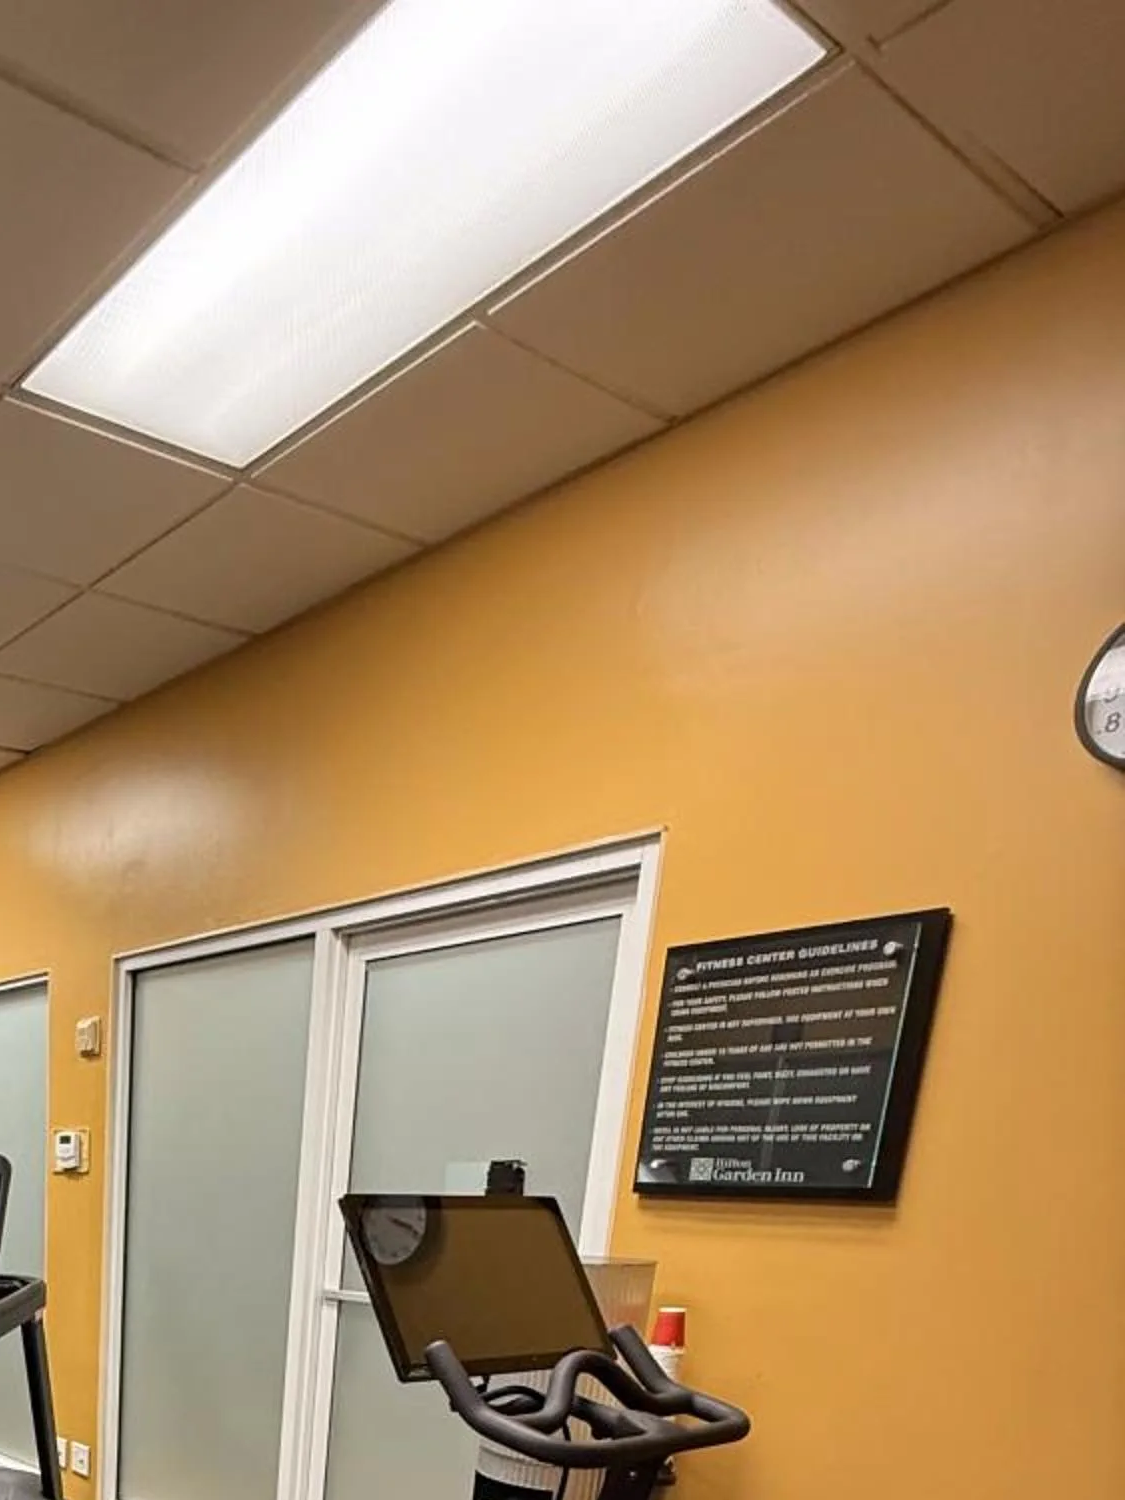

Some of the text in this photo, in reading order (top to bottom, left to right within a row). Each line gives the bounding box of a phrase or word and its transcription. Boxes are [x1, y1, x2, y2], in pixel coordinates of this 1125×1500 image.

[1105, 712, 1121, 732] 8
[696, 939, 879, 972] FITNESS CENTER GUIDELINES
[713, 1167, 805, 1182] Garden Inn
